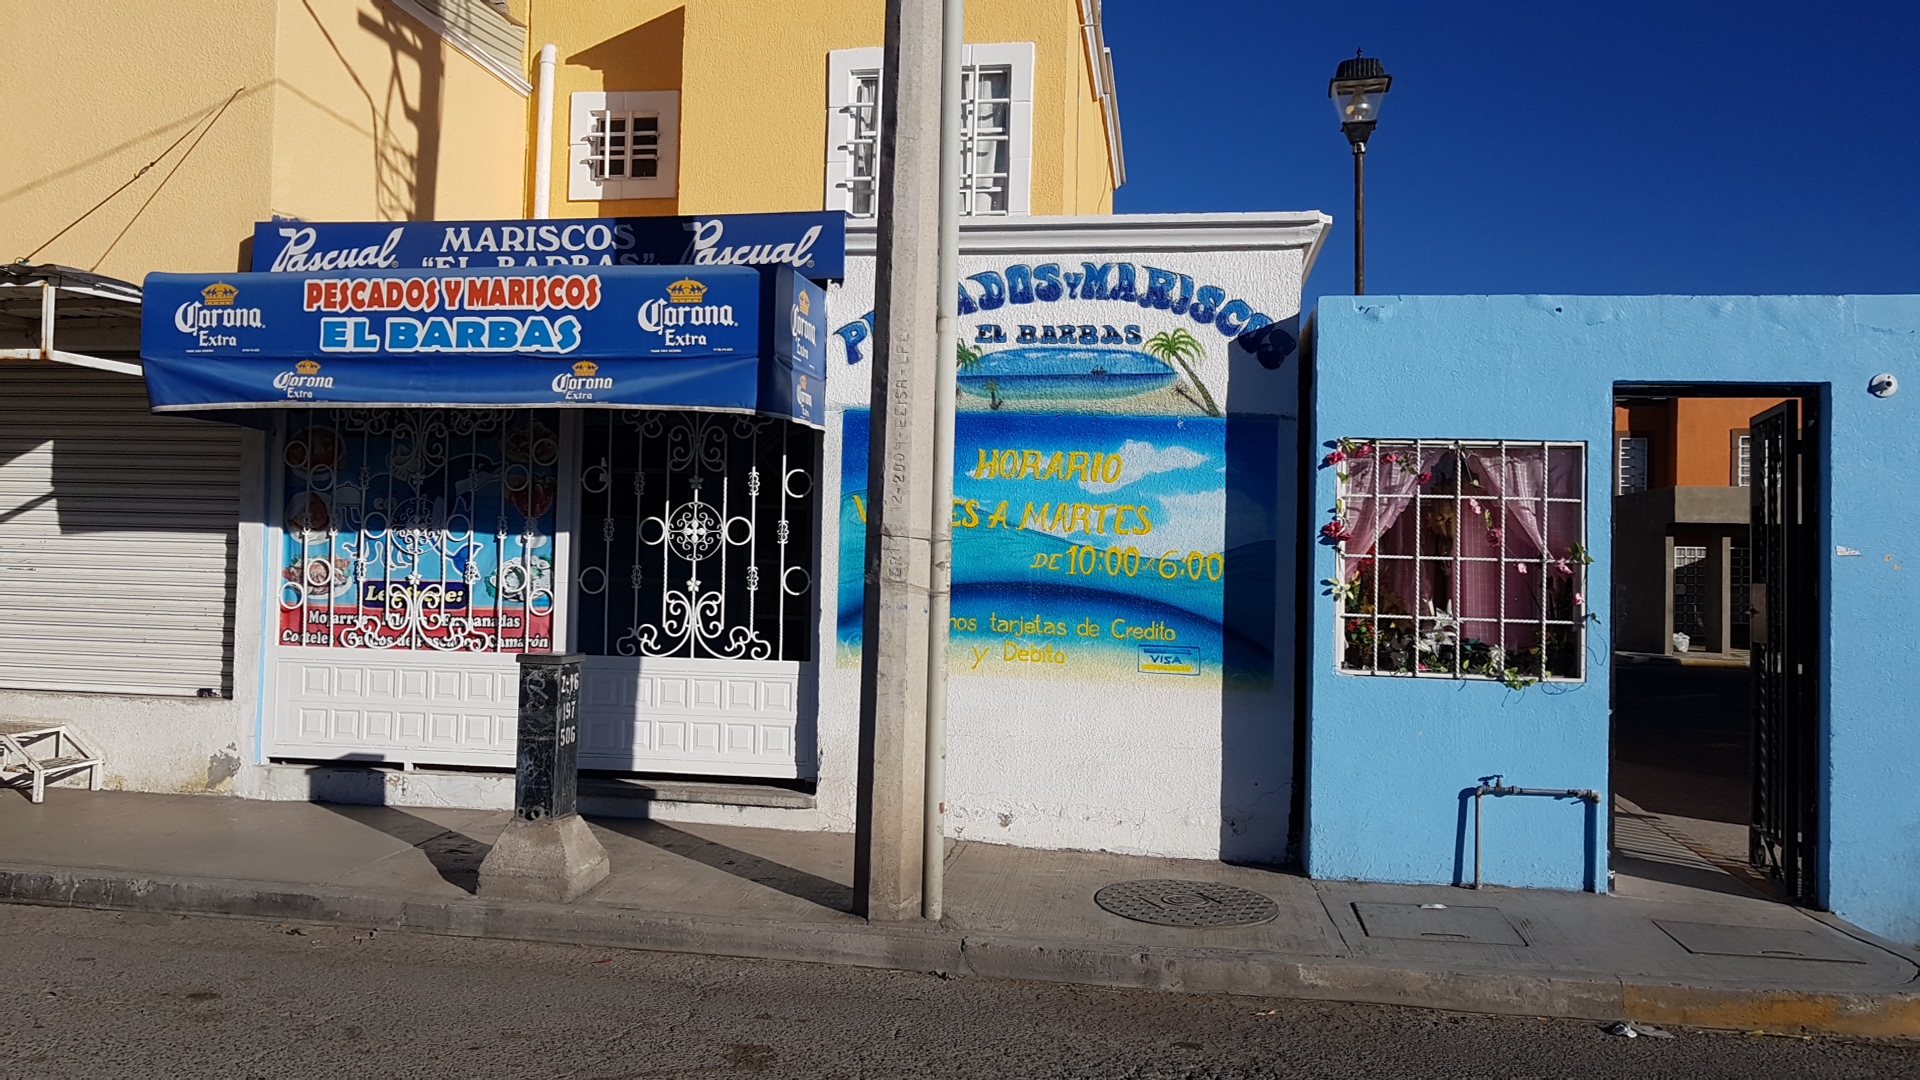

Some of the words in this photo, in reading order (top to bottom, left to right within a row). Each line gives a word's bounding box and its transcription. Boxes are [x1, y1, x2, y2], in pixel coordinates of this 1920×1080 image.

[270, 226, 404, 272] Pascual
[440, 223, 636, 252] MARISCOS
[679, 218, 824, 268] Pascual
[303, 276, 440, 312] PESCADOS
[444, 276, 464, 311] Y
[467, 274, 602, 312] MARISCOS
[174, 301, 262, 336] Corona
[637, 297, 735, 336] Corona
[790, 303, 817, 348] Corona
[1080, 261, 1298, 370] MARISCOS
[198, 330, 238, 347] Extra
[320, 316, 381, 353] EL
[384, 314, 582, 354] BARBAS
[664, 328, 708, 347] Extra
[975, 324, 1007, 344] EL
[1016, 324, 1143, 345] BARBAS
[272, 371, 334, 391] Corona
[287, 387, 313, 399] Extra
[551, 372, 613, 394] Corona
[564, 390, 593, 400] Extra
[974, 449, 1123, 484] HORARIO
[988, 500, 1010, 530] A
[1015, 501, 1153, 536] MARTES
[1030, 552, 1063, 571] DE
[1066, 544, 1140, 578] 10:00
[1157, 549, 1225, 582] 6:00
[990, 612, 1068, 638] tarjetas
[1076, 617, 1100, 638] de
[1111, 618, 1177, 643] Credito
[1003, 641, 1067, 665] Debito
[1148, 654, 1183, 666] VISA
